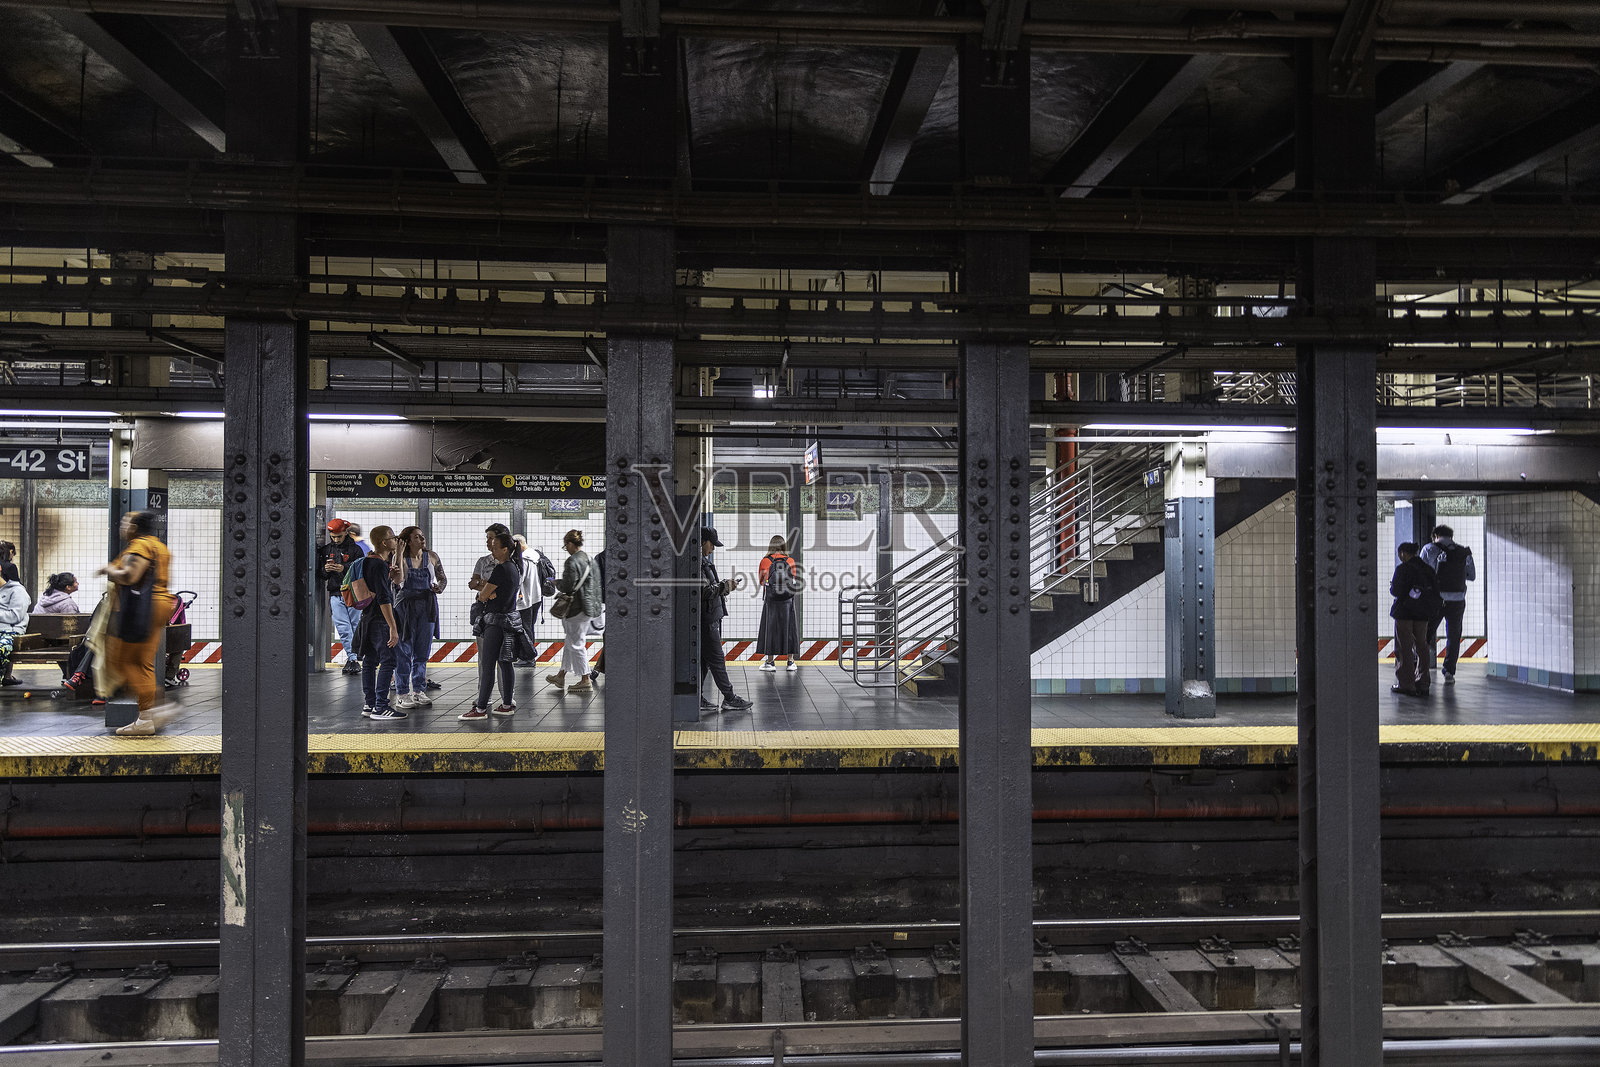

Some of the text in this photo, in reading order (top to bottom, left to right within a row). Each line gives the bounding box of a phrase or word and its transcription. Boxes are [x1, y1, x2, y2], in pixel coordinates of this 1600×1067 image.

[57, 449, 86, 472] St
[150, 494, 162, 508] 42
[829, 493, 851, 511] 42
